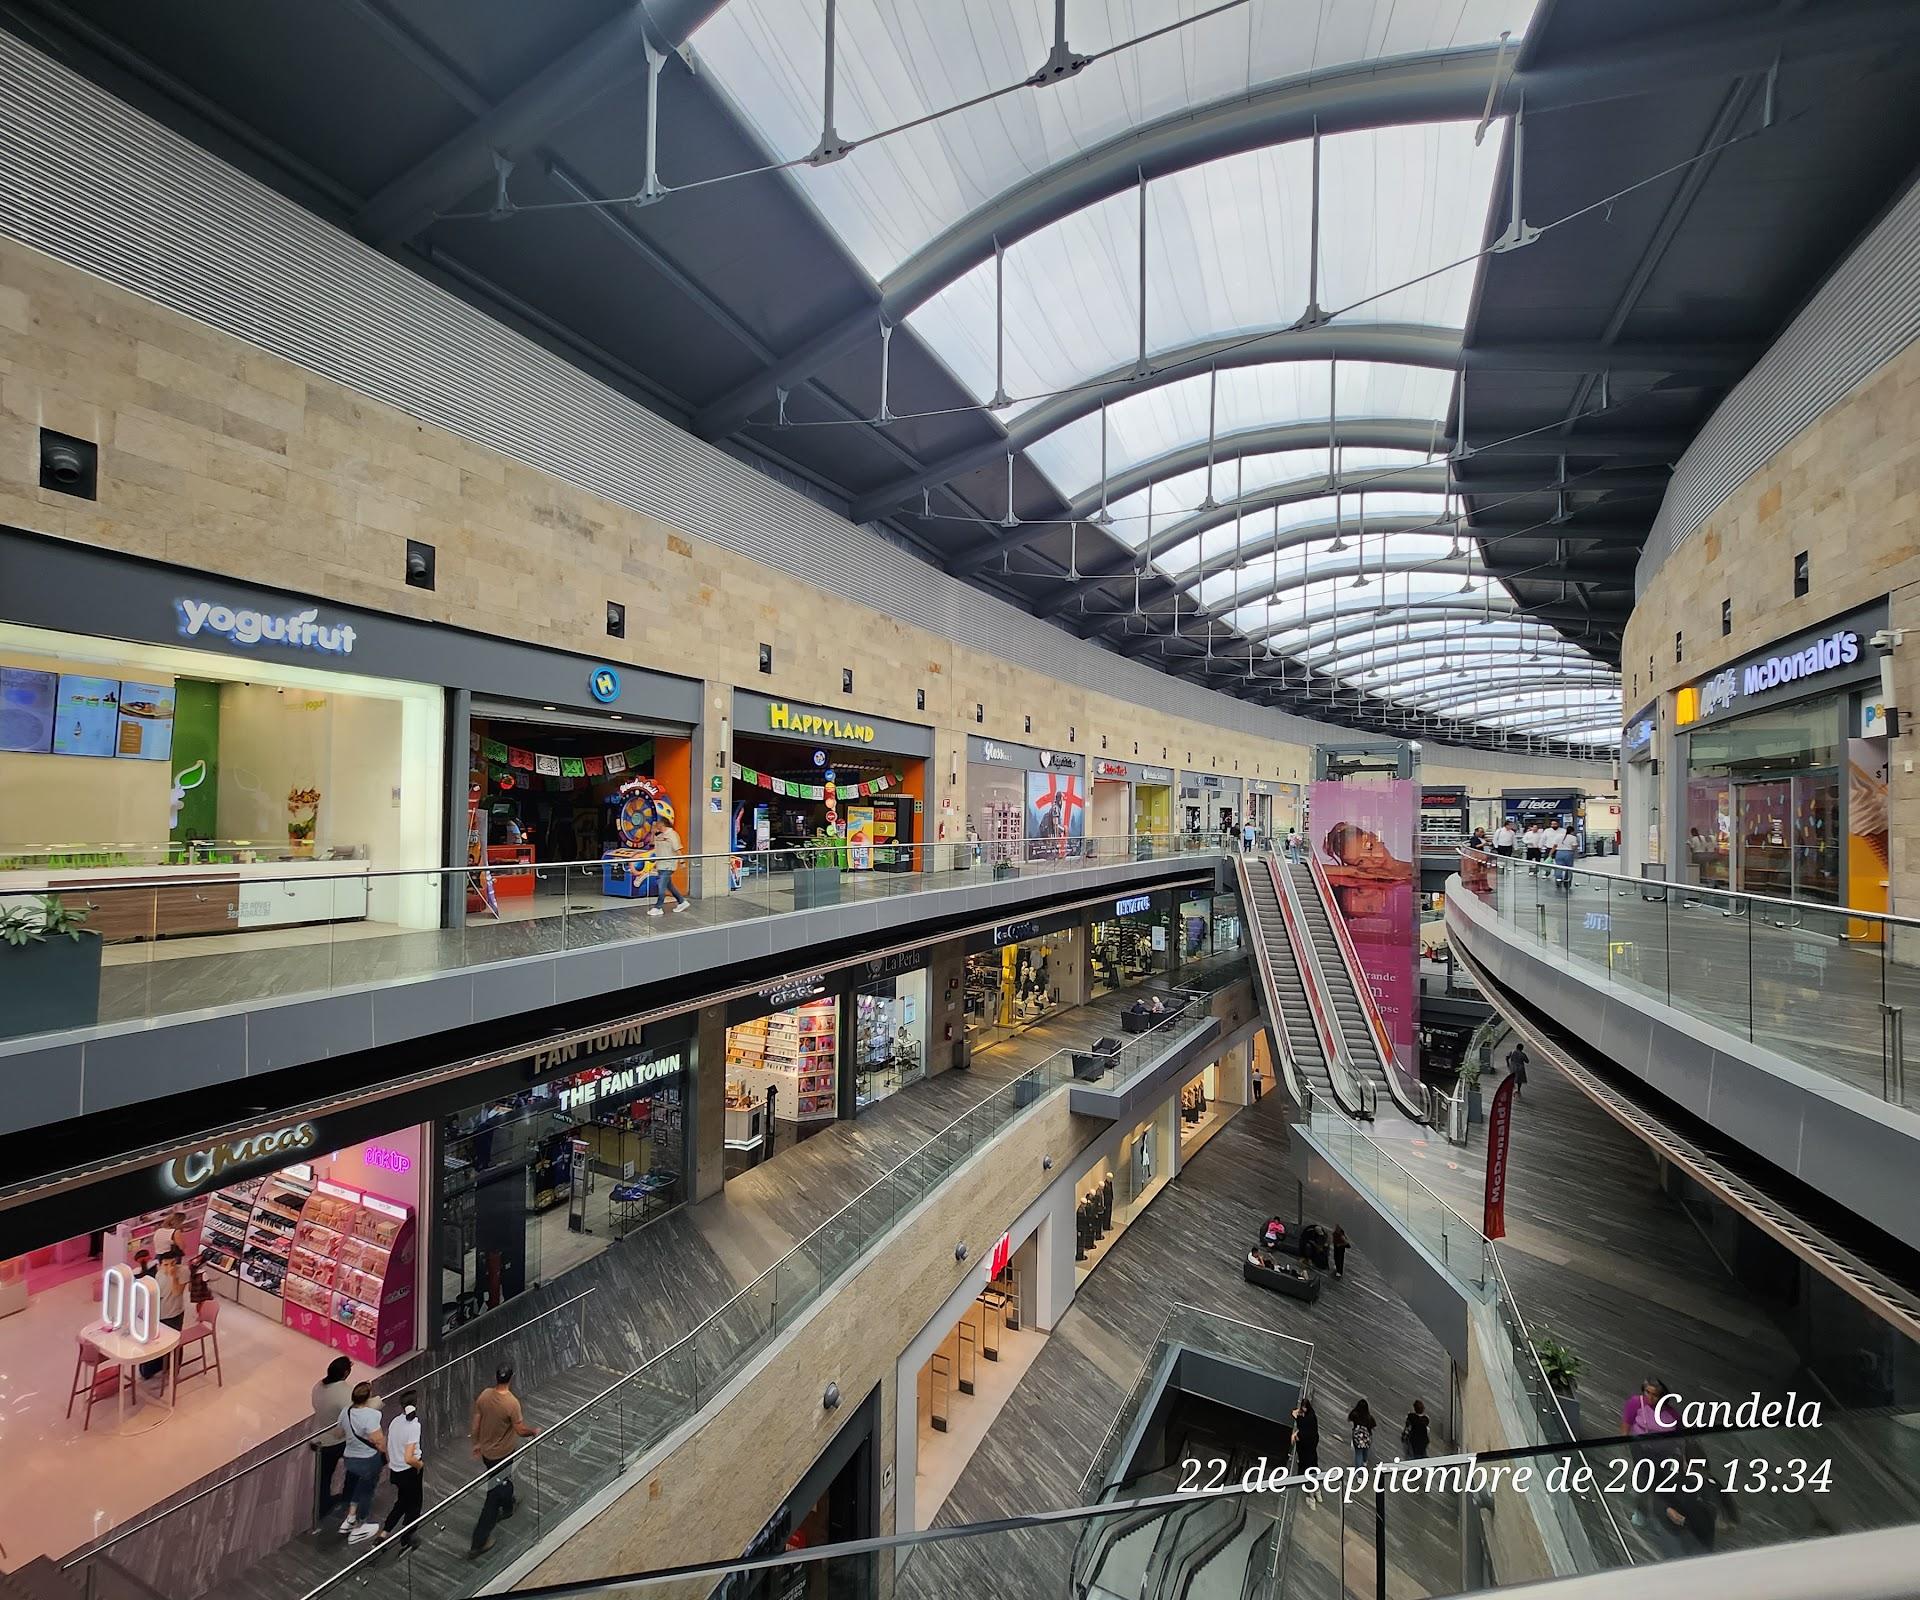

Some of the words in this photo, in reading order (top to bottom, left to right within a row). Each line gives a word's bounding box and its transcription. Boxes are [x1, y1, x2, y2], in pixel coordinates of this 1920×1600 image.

[183, 600, 357, 653] yogufrut
[1743, 631, 1858, 696] McDonald's
[597, 674, 615, 695] H
[1527, 800, 1561, 810] telcel
[885, 957, 898, 972] La
[898, 950, 921, 968] Perla
[1366, 972, 1398, 982] rande
[534, 1042, 579, 1075] FAN
[559, 1079, 599, 1112] THE
[600, 1068, 635, 1098] FAN
[636, 1053, 681, 1084] TOWN
[170, 1124, 316, 1190] Chicas
